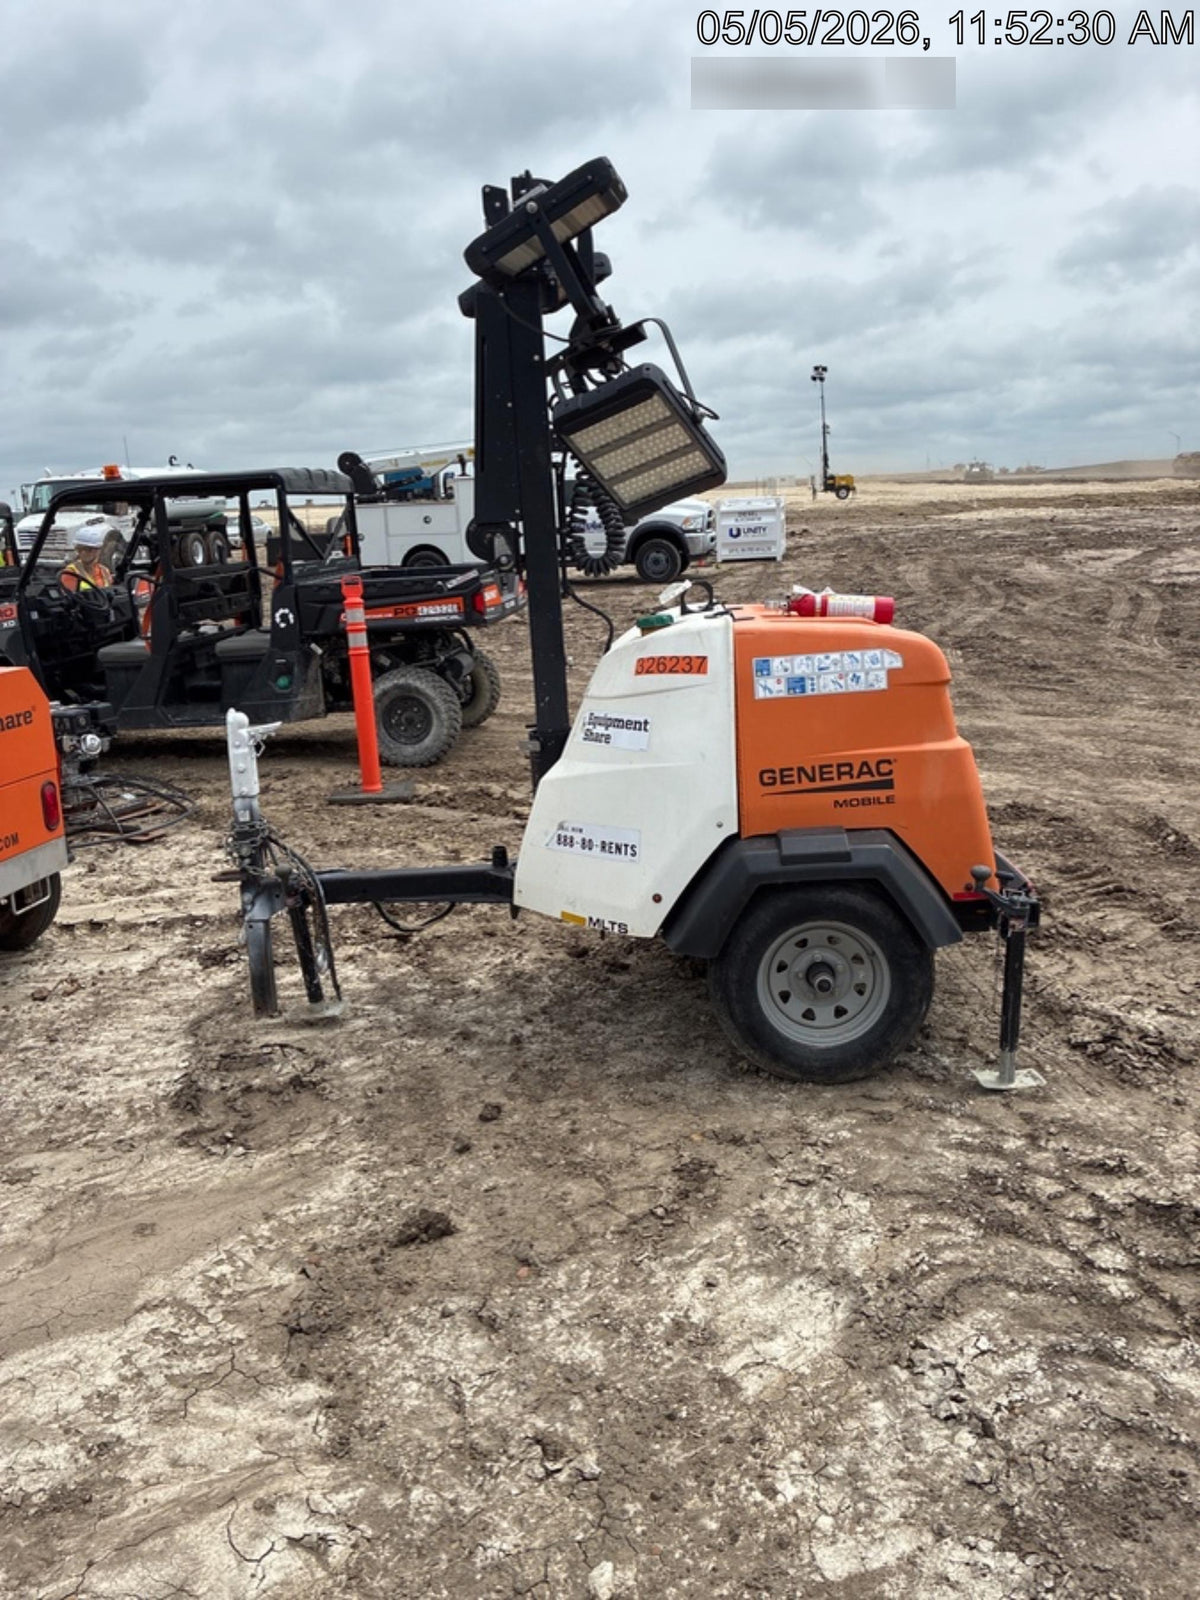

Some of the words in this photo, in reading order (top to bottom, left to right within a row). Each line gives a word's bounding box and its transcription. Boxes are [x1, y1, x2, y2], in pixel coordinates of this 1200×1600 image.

[742, 526, 768, 534] UNITY
[636, 655, 708, 674] 326237
[587, 712, 650, 732] Equipment
[582, 728, 612, 744] Share
[758, 758, 894, 787] GENERAC
[833, 795, 896, 809] MOBILE
[556, 833, 637, 857] 888-80-RENTS
[588, 916, 628, 934] MLTS
